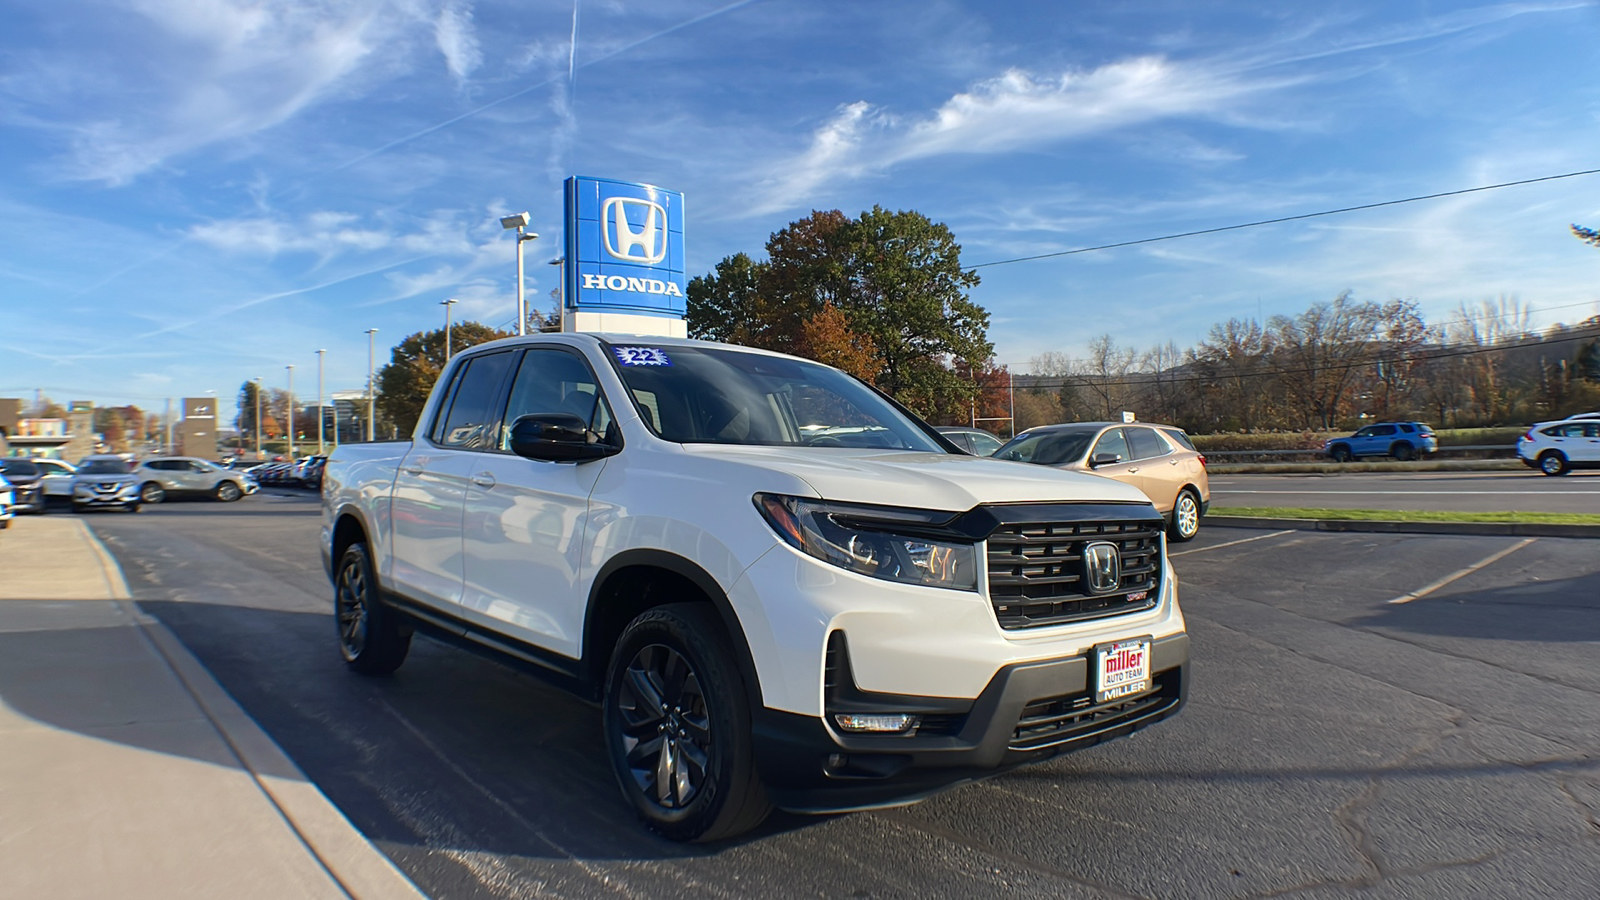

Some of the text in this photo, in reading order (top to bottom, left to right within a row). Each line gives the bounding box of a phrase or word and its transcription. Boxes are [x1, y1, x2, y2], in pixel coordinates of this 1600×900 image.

[582, 274, 683, 297] HONDA
[627, 349, 658, 361] 22
[1106, 650, 1142, 673] miller
[1107, 668, 1142, 684] AUTO TEAM
[1104, 681, 1146, 701] MILLER
